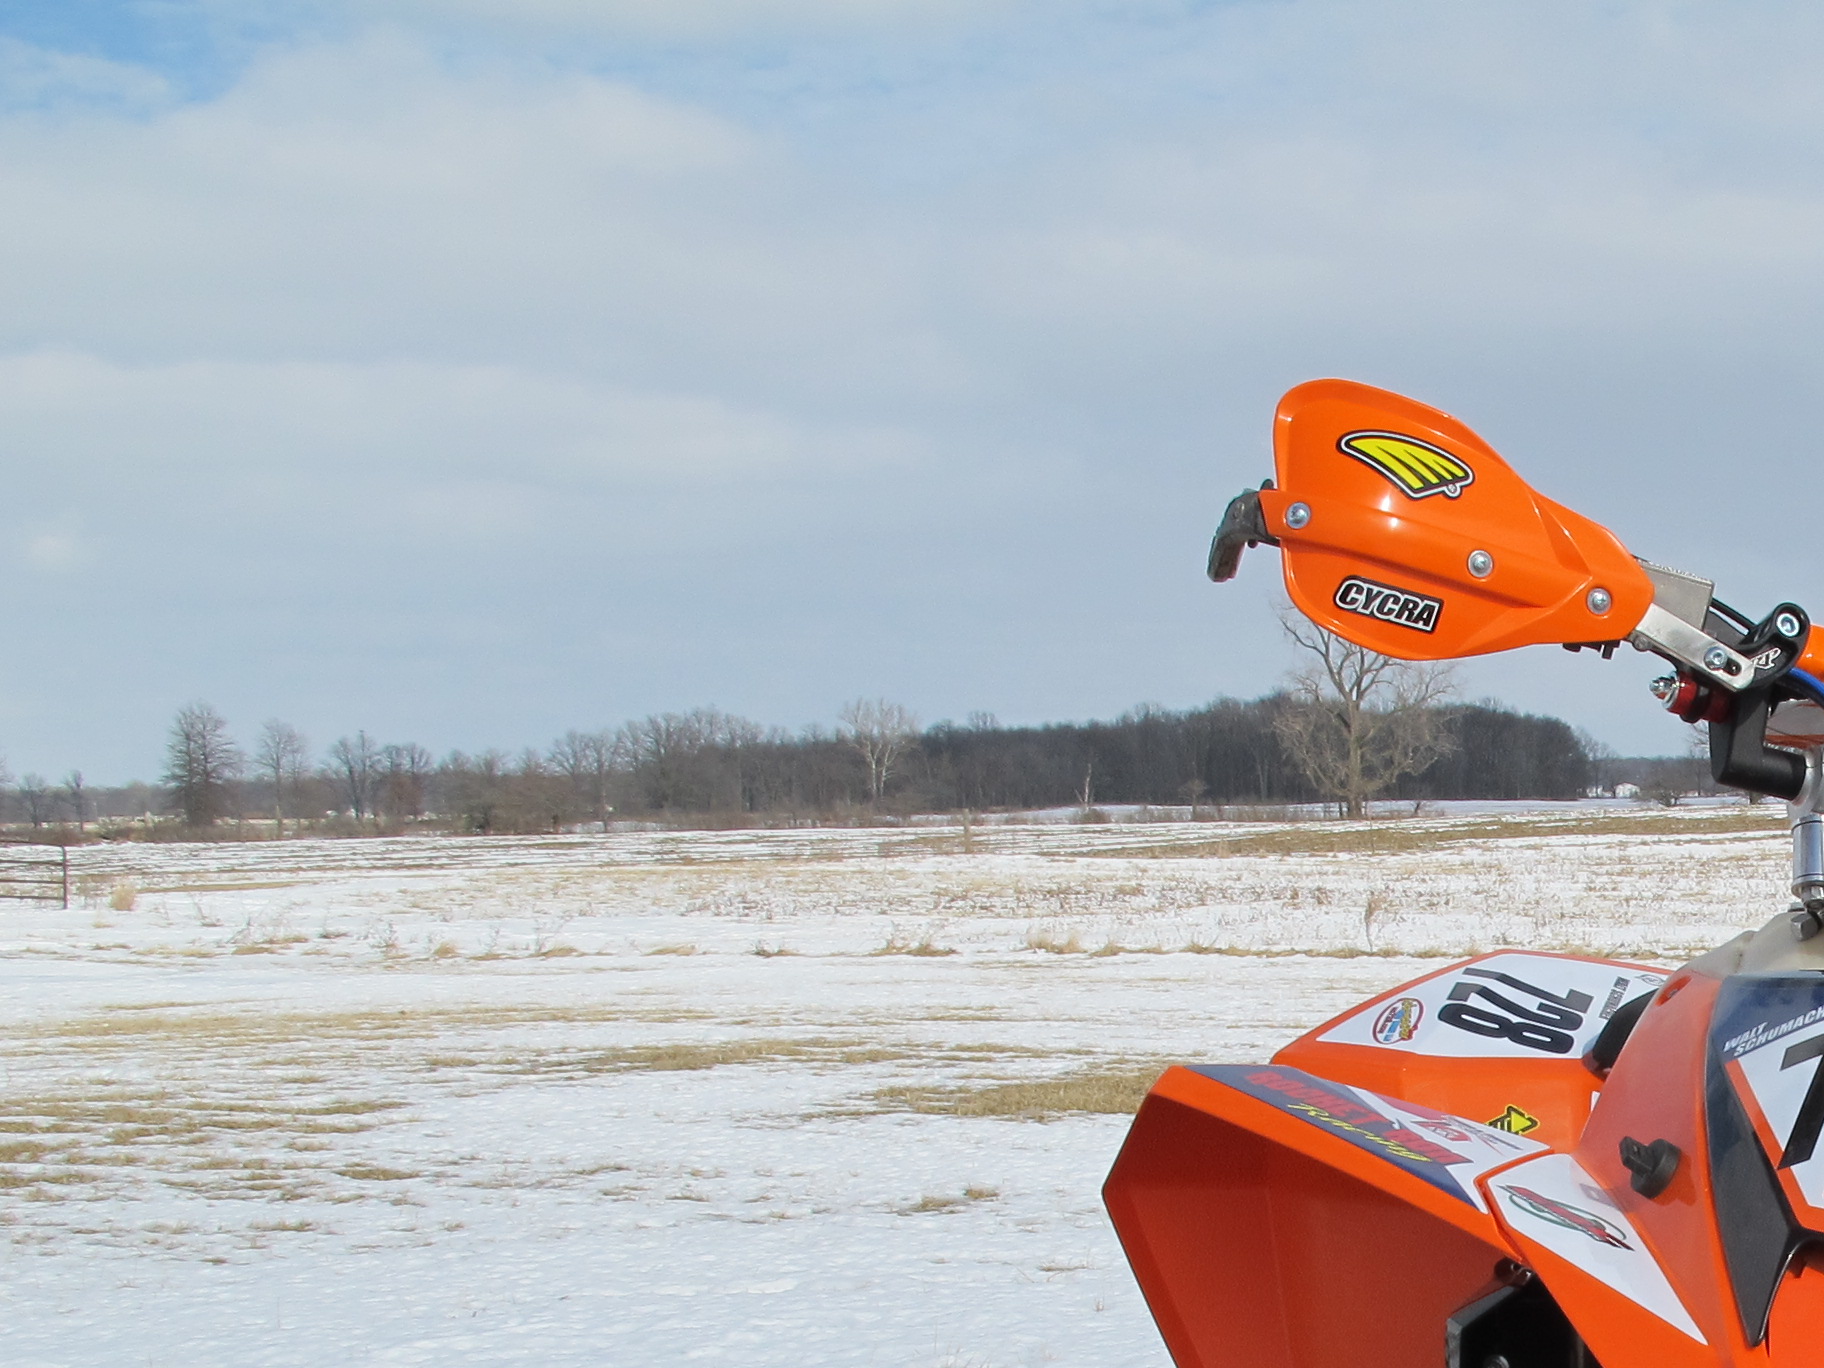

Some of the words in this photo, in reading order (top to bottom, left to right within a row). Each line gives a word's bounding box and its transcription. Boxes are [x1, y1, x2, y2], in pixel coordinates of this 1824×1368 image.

[1336, 579, 1439, 631] CYCRA
[1437, 967, 1595, 1054] 728
[1723, 1022, 1768, 1052] WALT
